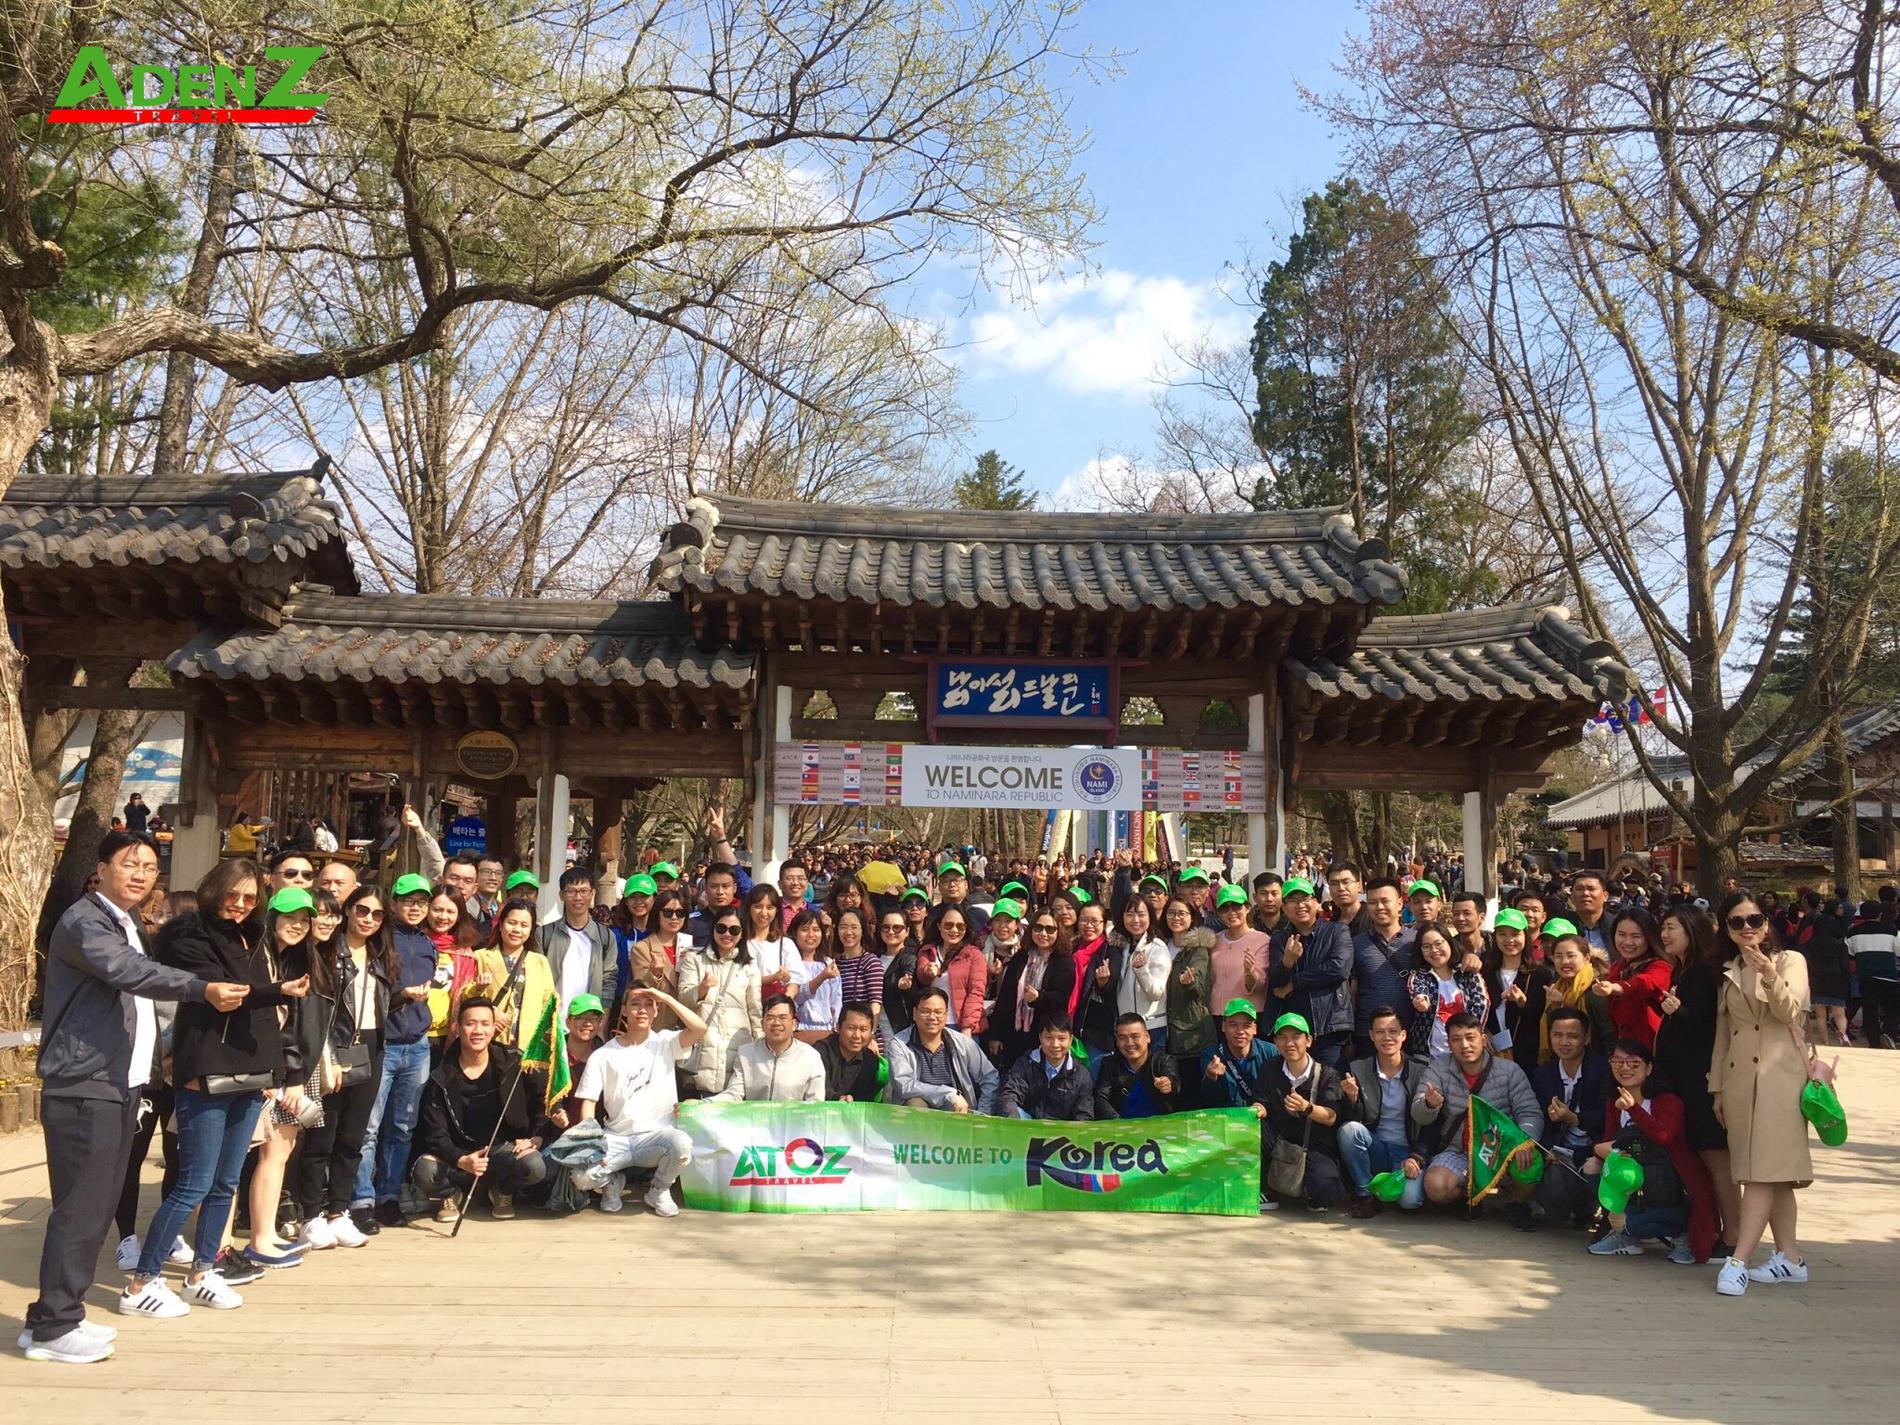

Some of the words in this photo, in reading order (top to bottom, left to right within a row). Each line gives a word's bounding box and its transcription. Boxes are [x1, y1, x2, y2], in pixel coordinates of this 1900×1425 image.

[925, 765, 1063, 789] WELCOME
[1086, 780, 1108, 788] NAMI
[926, 789, 939, 800] TO
[943, 790, 1007, 801] NAMINARA
[1011, 791, 1064, 802] REPUBLIC
[732, 1137, 853, 1178] ATOZ
[893, 1143, 983, 1165] WELCOME
[991, 1147, 1013, 1165] TO
[1025, 1136, 1169, 1190] Korea
[765, 1177, 816, 1186] TRAVEL
